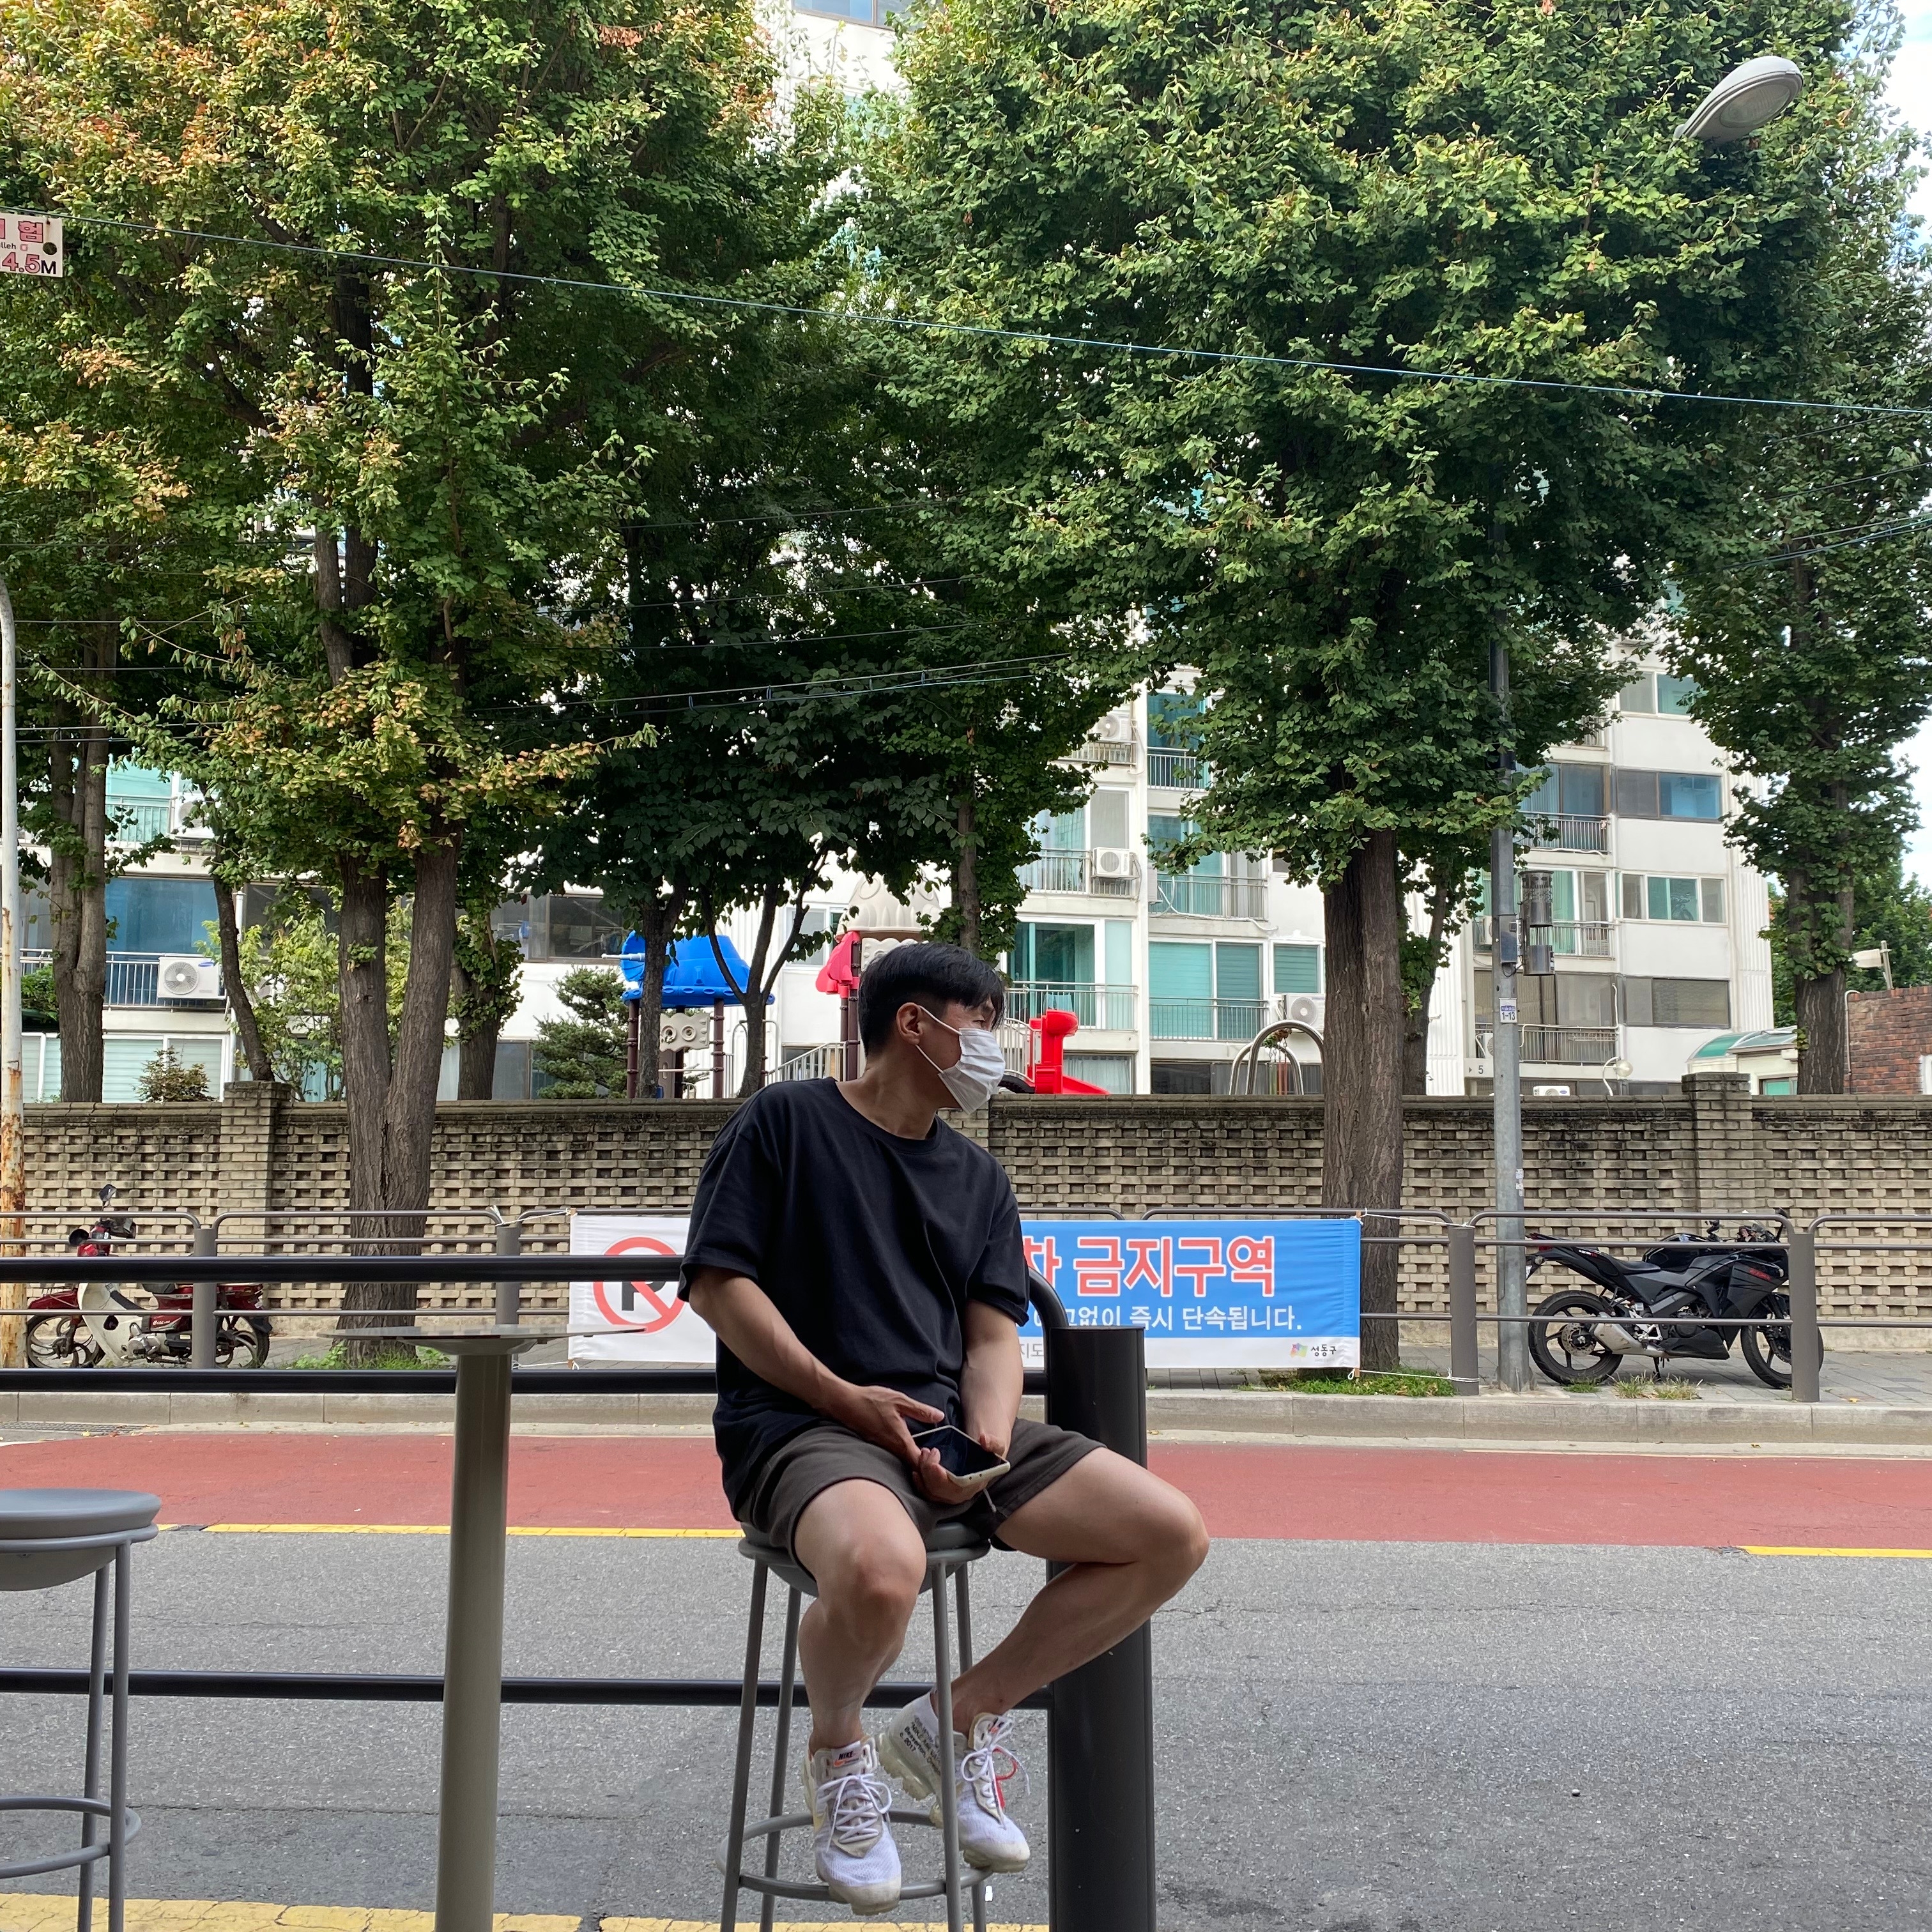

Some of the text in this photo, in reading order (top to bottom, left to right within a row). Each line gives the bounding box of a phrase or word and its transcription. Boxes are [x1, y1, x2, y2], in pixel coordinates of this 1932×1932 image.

[0, 241, 17, 250] lleh
[2, 251, 56, 275] 4.5M
[1501, 1011, 1515, 1021] 1-13
[1478, 1065, 1483, 1075] 5
[1073, 1236, 1275, 1298] 금지구역
[1130, 1305, 1172, 1331] 즉시
[1183, 1305, 1302, 1331] 단속됩니다.
[1310, 1344, 1337, 1357] 성동구
